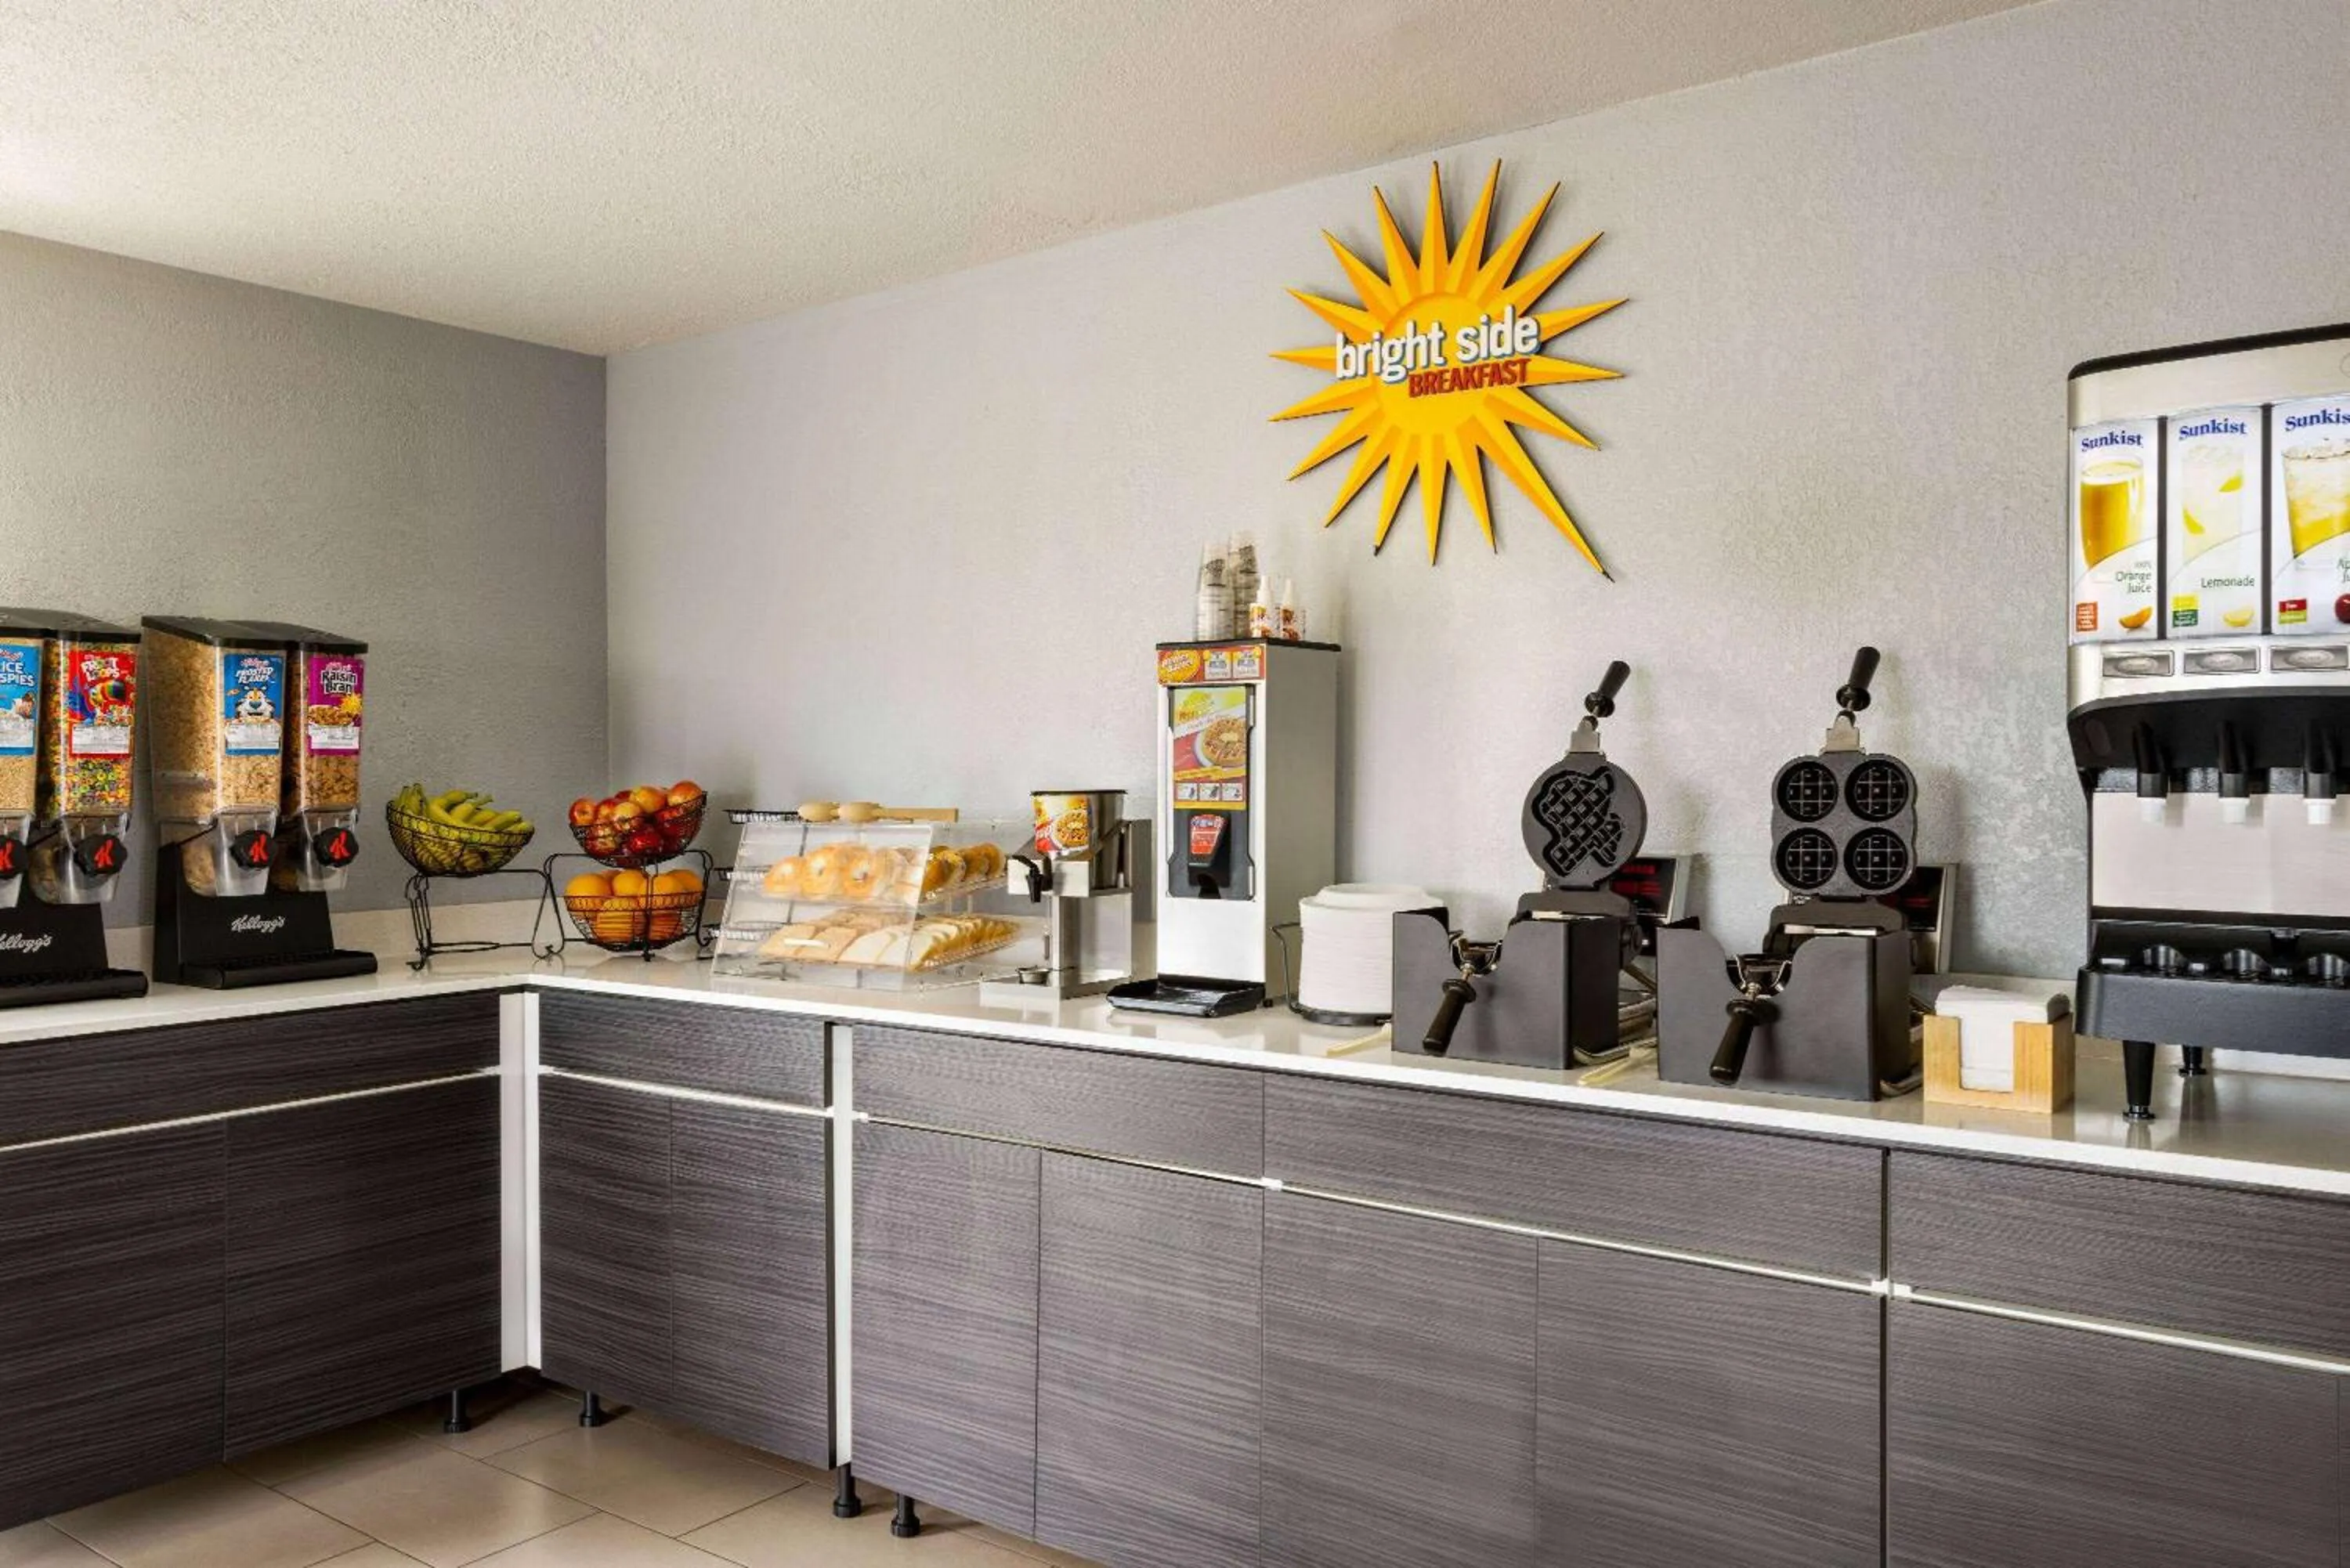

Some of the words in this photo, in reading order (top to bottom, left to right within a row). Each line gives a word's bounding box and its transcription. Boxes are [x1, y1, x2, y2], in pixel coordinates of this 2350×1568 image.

[1335, 320, 1446, 383] bright
[1456, 304, 1542, 363] side
[1408, 358, 1531, 399] BREAKFAST
[2285, 408, 2350, 432] Sunkis
[2178, 417, 2247, 441] Sunkist
[2081, 430, 2144, 452] Sunkist
[2116, 571, 2151, 583] Orange
[2200, 575, 2255, 588] Lemonade
[2127, 583, 2151, 594] Juice
[0, 661, 24, 674] ICE
[0, 673, 34, 687] SPIES
[321, 670, 357, 685] Raisin
[231, 915, 286, 932] Kellogg's
